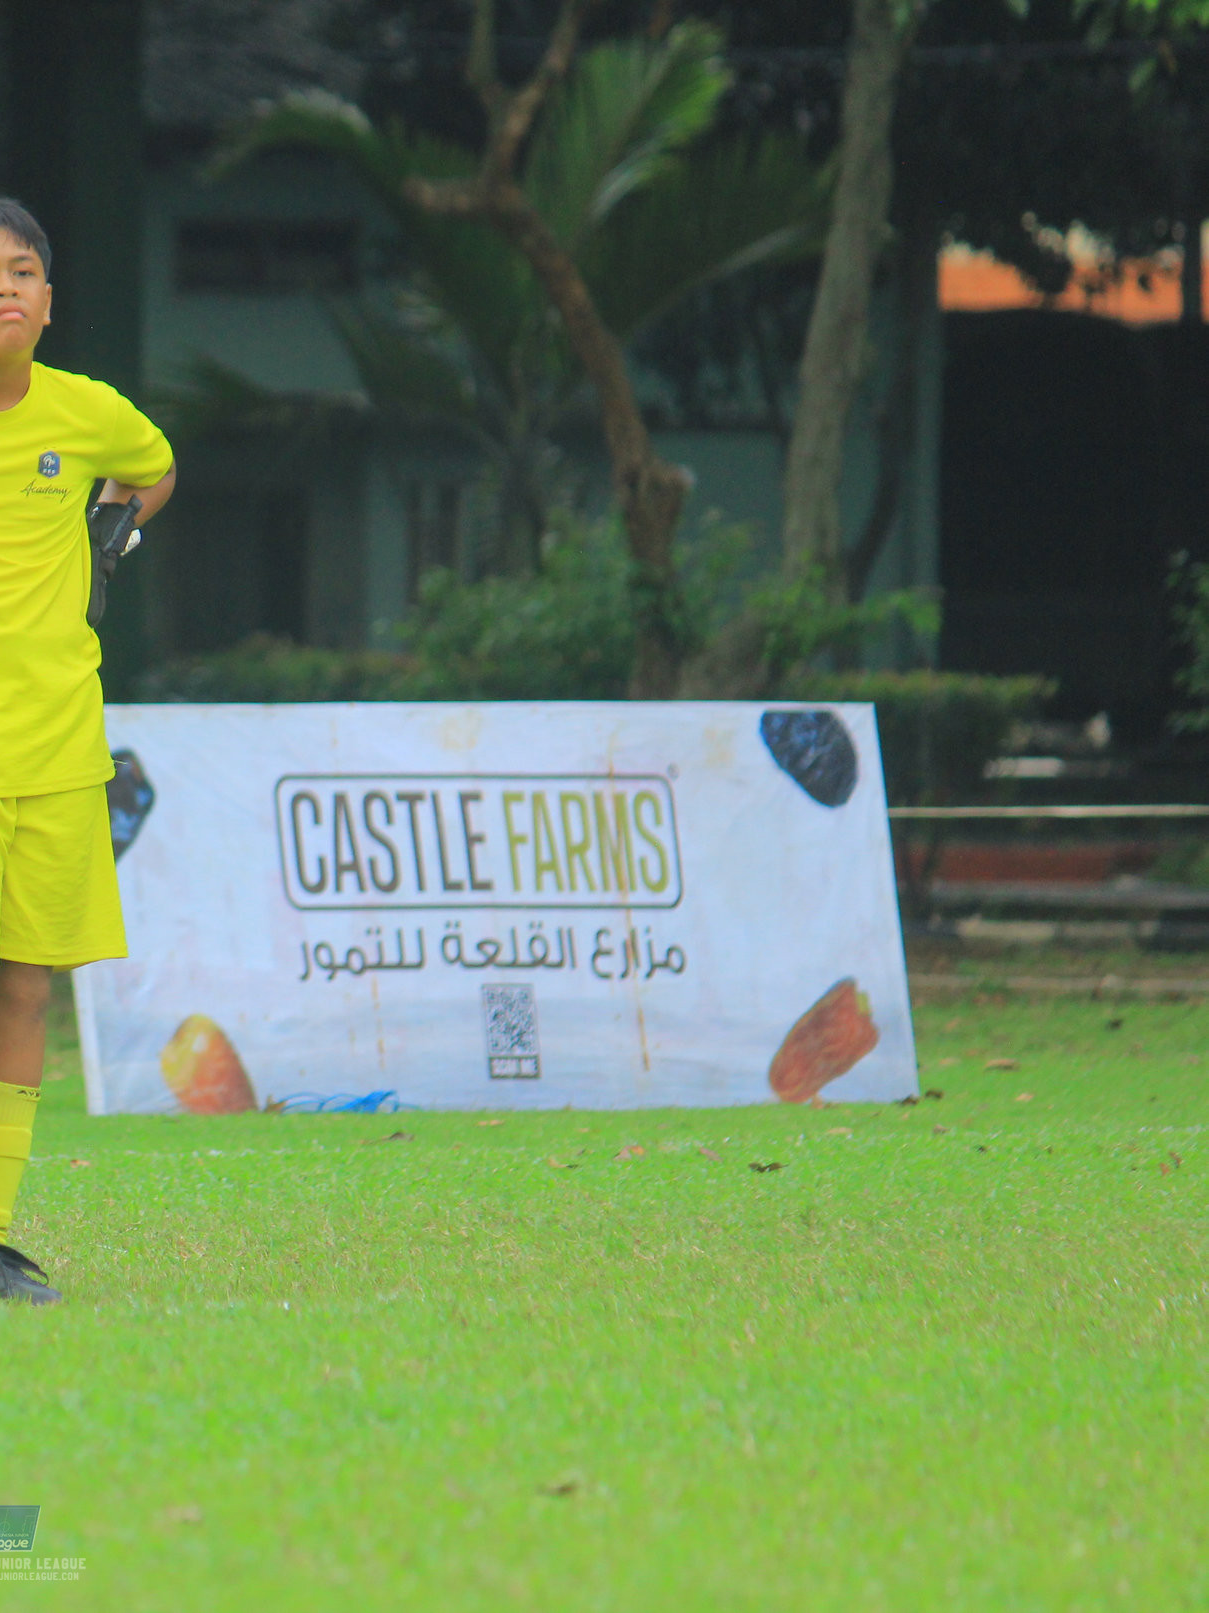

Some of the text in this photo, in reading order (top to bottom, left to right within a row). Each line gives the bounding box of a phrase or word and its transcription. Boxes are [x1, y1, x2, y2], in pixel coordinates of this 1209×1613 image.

[20, 478, 71, 503] Academy
[290, 790, 670, 894] CASTLE FARMS
[298, 921, 687, 981] مزارع القلعة للتمور
